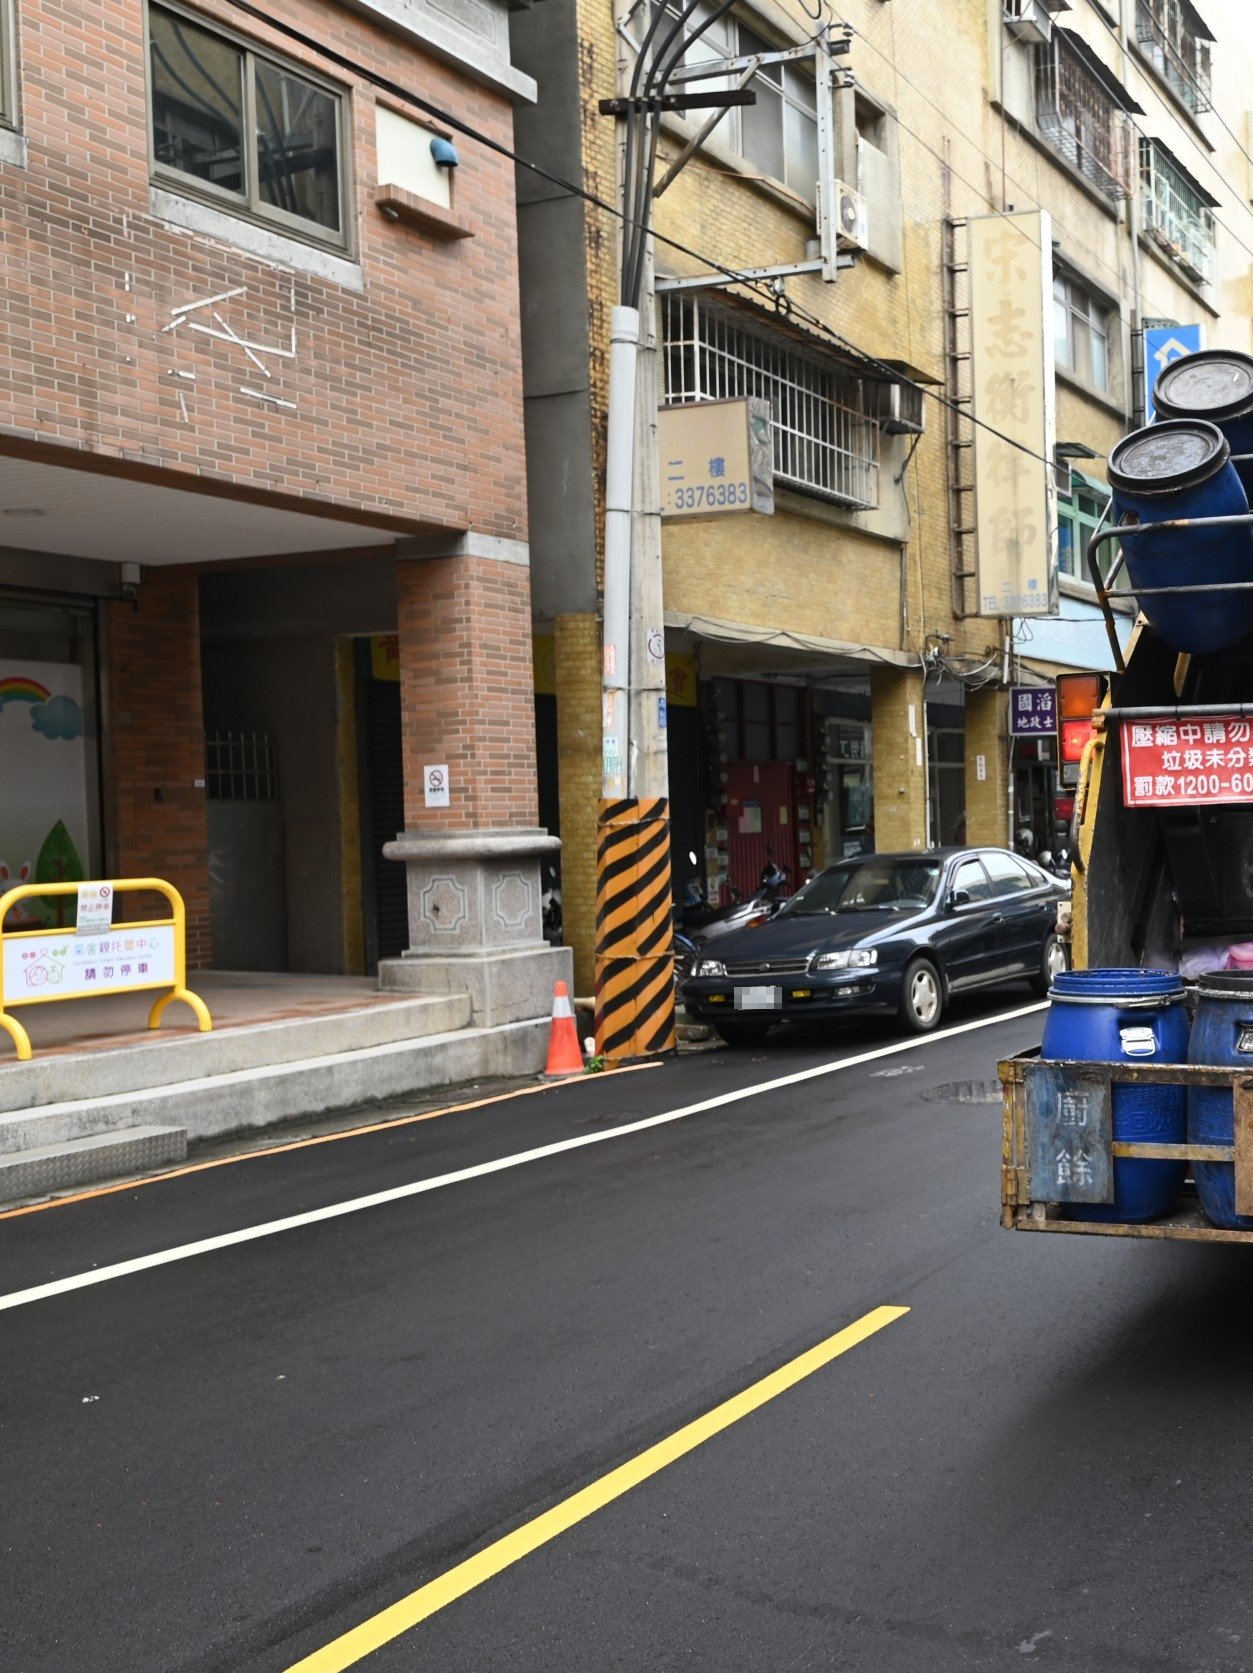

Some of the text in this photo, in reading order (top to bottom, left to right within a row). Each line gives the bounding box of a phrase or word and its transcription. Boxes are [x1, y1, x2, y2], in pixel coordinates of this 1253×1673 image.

[1017, 717, 1053, 728] 地政士
[84, 962, 148, 981] 請勿停車
